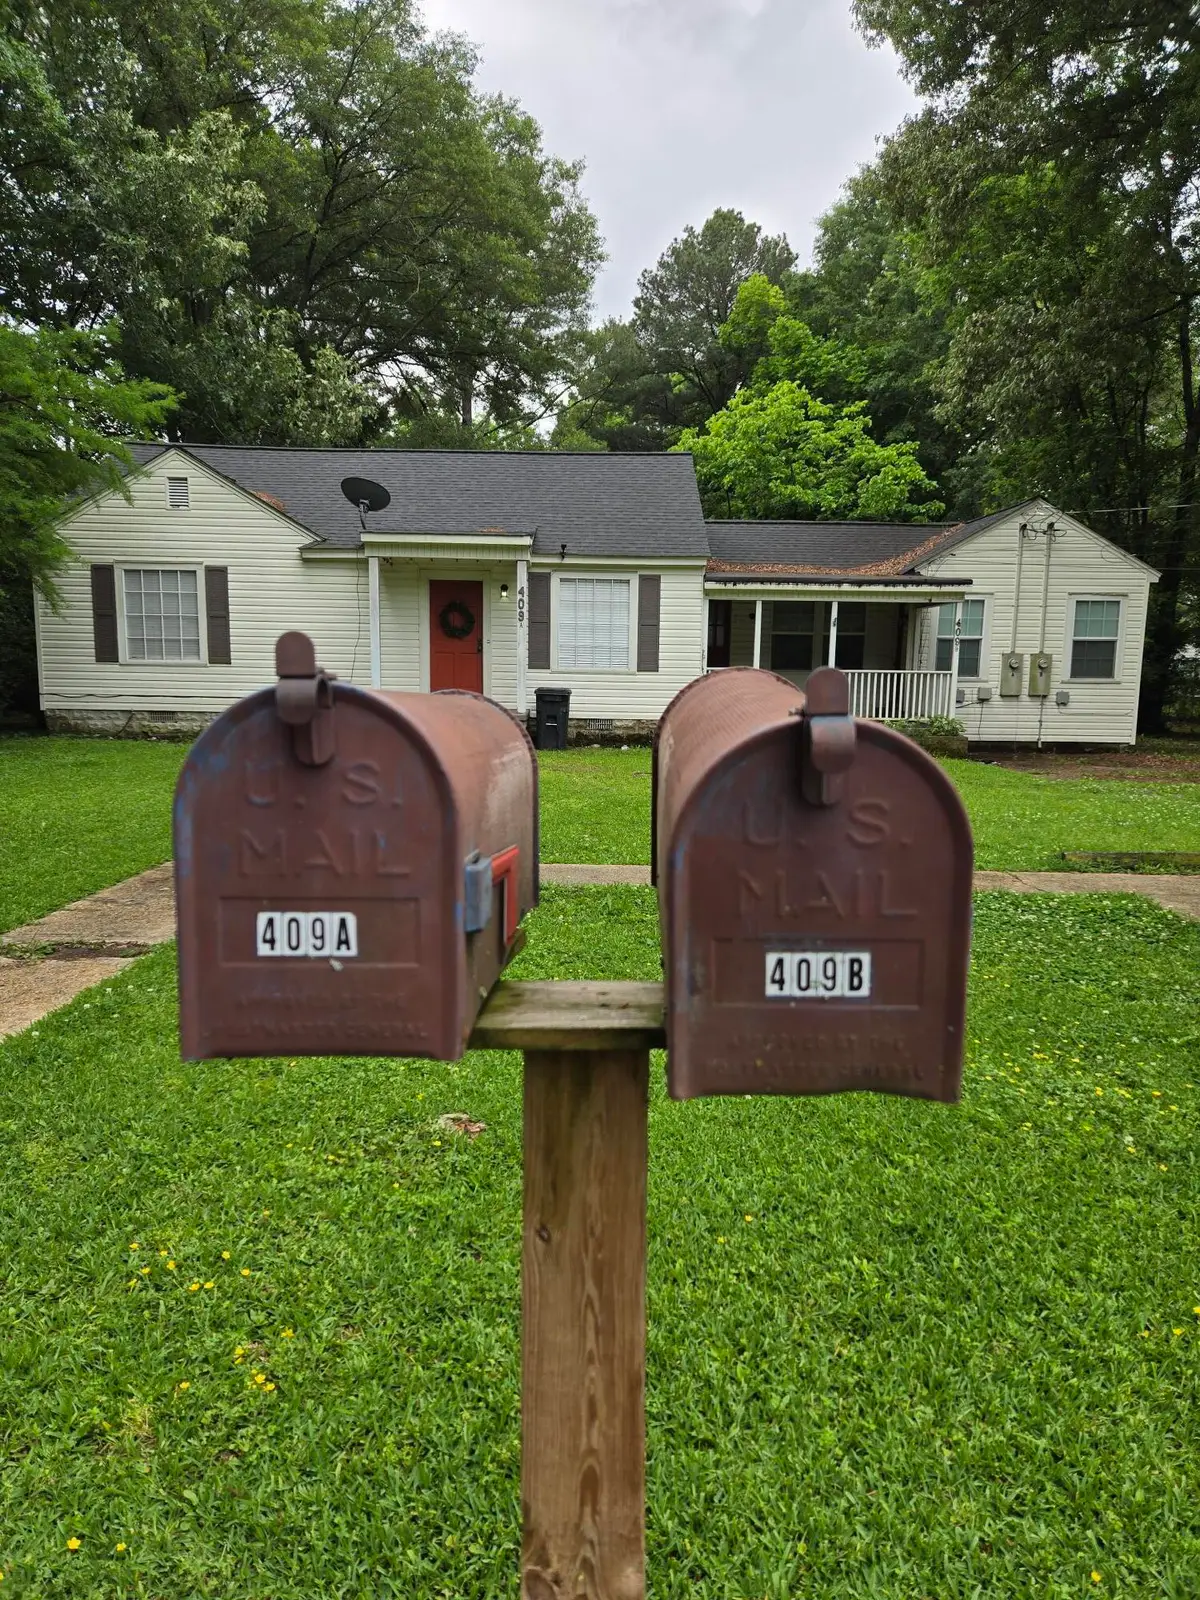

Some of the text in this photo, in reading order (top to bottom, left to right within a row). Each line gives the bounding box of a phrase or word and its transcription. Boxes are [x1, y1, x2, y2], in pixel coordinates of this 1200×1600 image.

[238, 828, 412, 878] MAIL
[736, 865, 918, 919] MAIL
[262, 917, 351, 951] 409A
[769, 957, 864, 992] 409B
